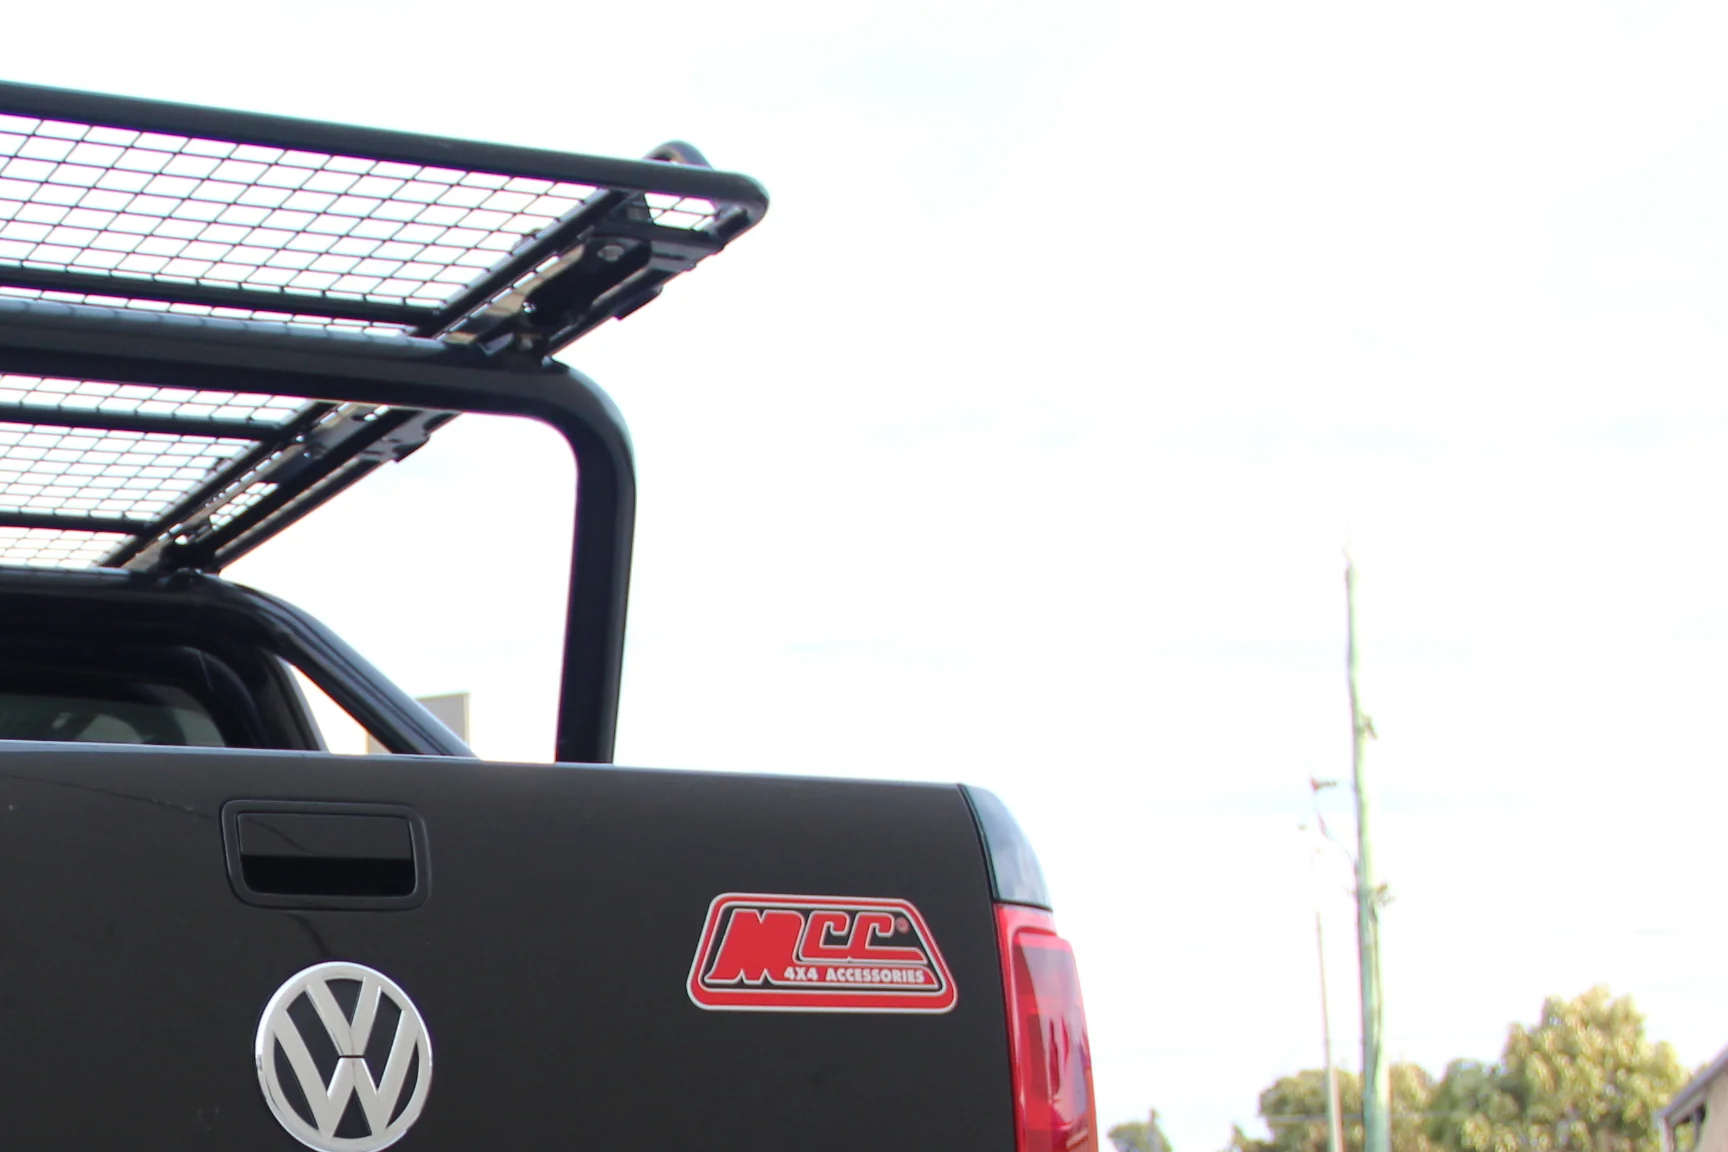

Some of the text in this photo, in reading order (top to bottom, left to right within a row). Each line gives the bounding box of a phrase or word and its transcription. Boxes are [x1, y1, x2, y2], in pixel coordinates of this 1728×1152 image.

[704, 908, 928, 985] MCC
[783, 965, 926, 984] 4X4 ACCESSORIES
